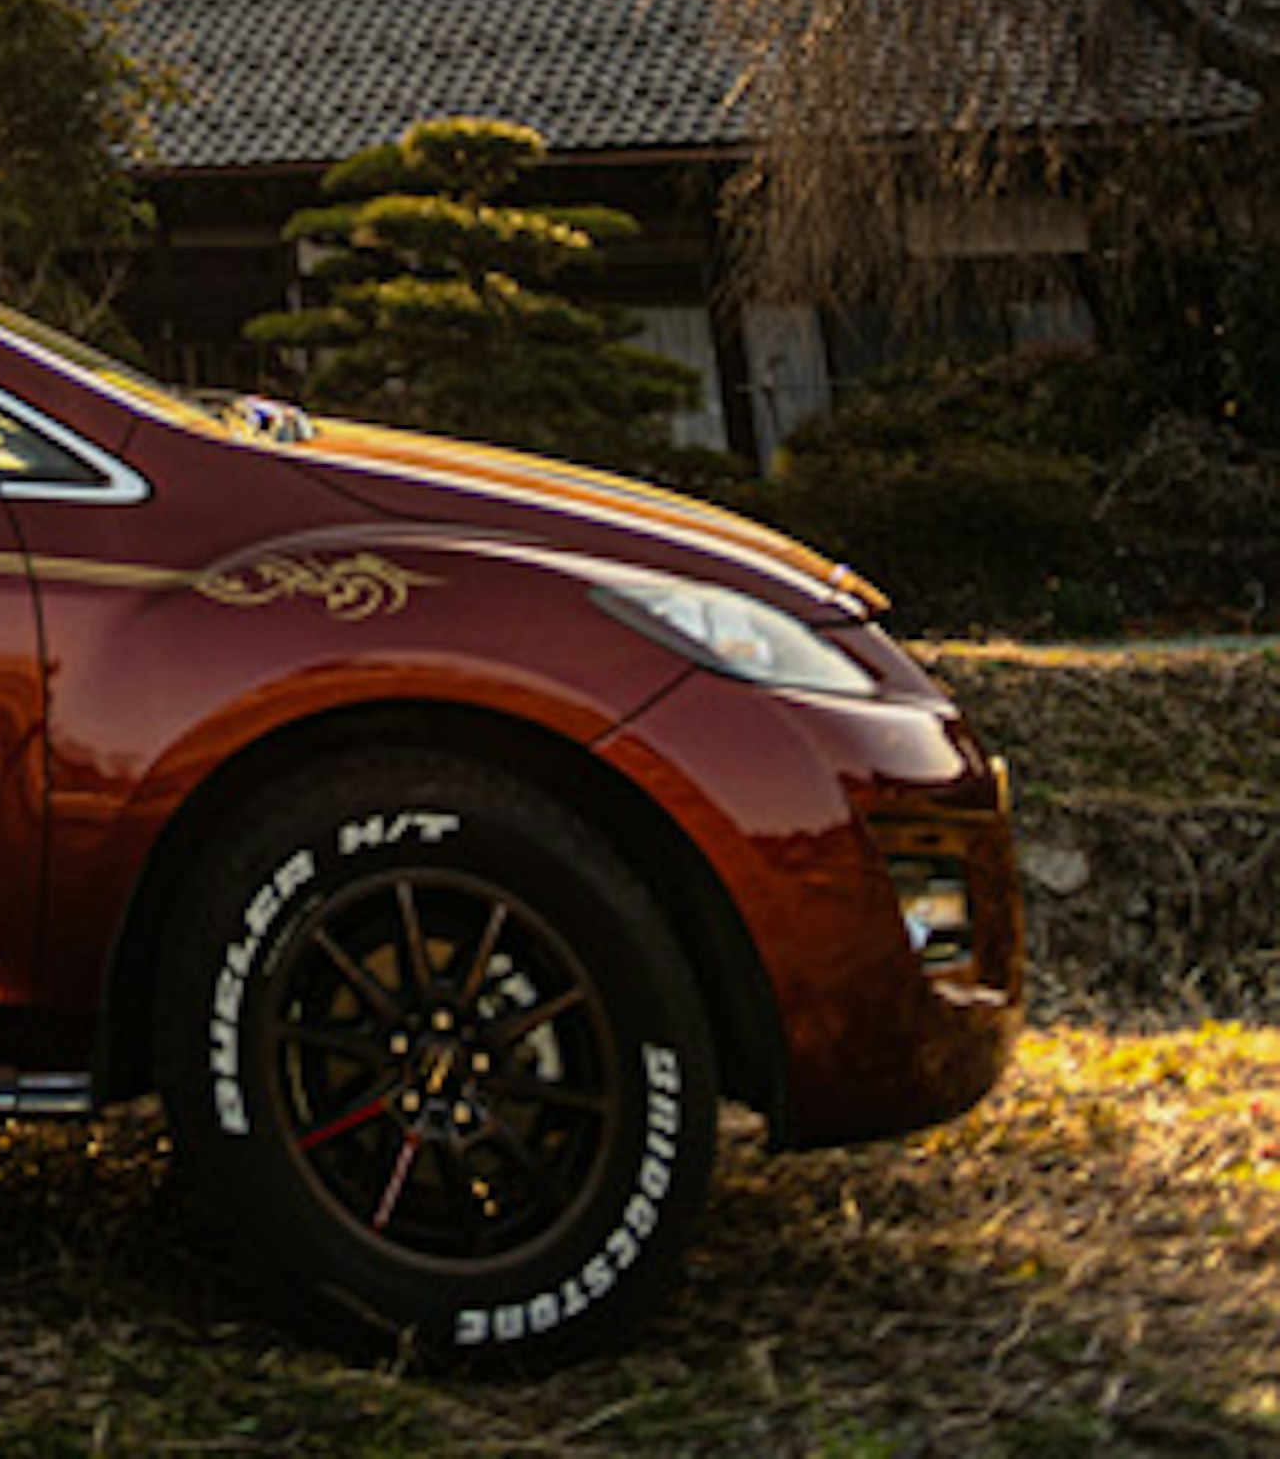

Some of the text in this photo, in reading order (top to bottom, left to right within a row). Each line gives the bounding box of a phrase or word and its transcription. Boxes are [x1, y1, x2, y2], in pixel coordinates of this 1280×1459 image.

[207, 848, 316, 1137] DUELER
[337, 811, 461, 856] H/T
[453, 1040, 684, 1347] BRIDGESTONE
